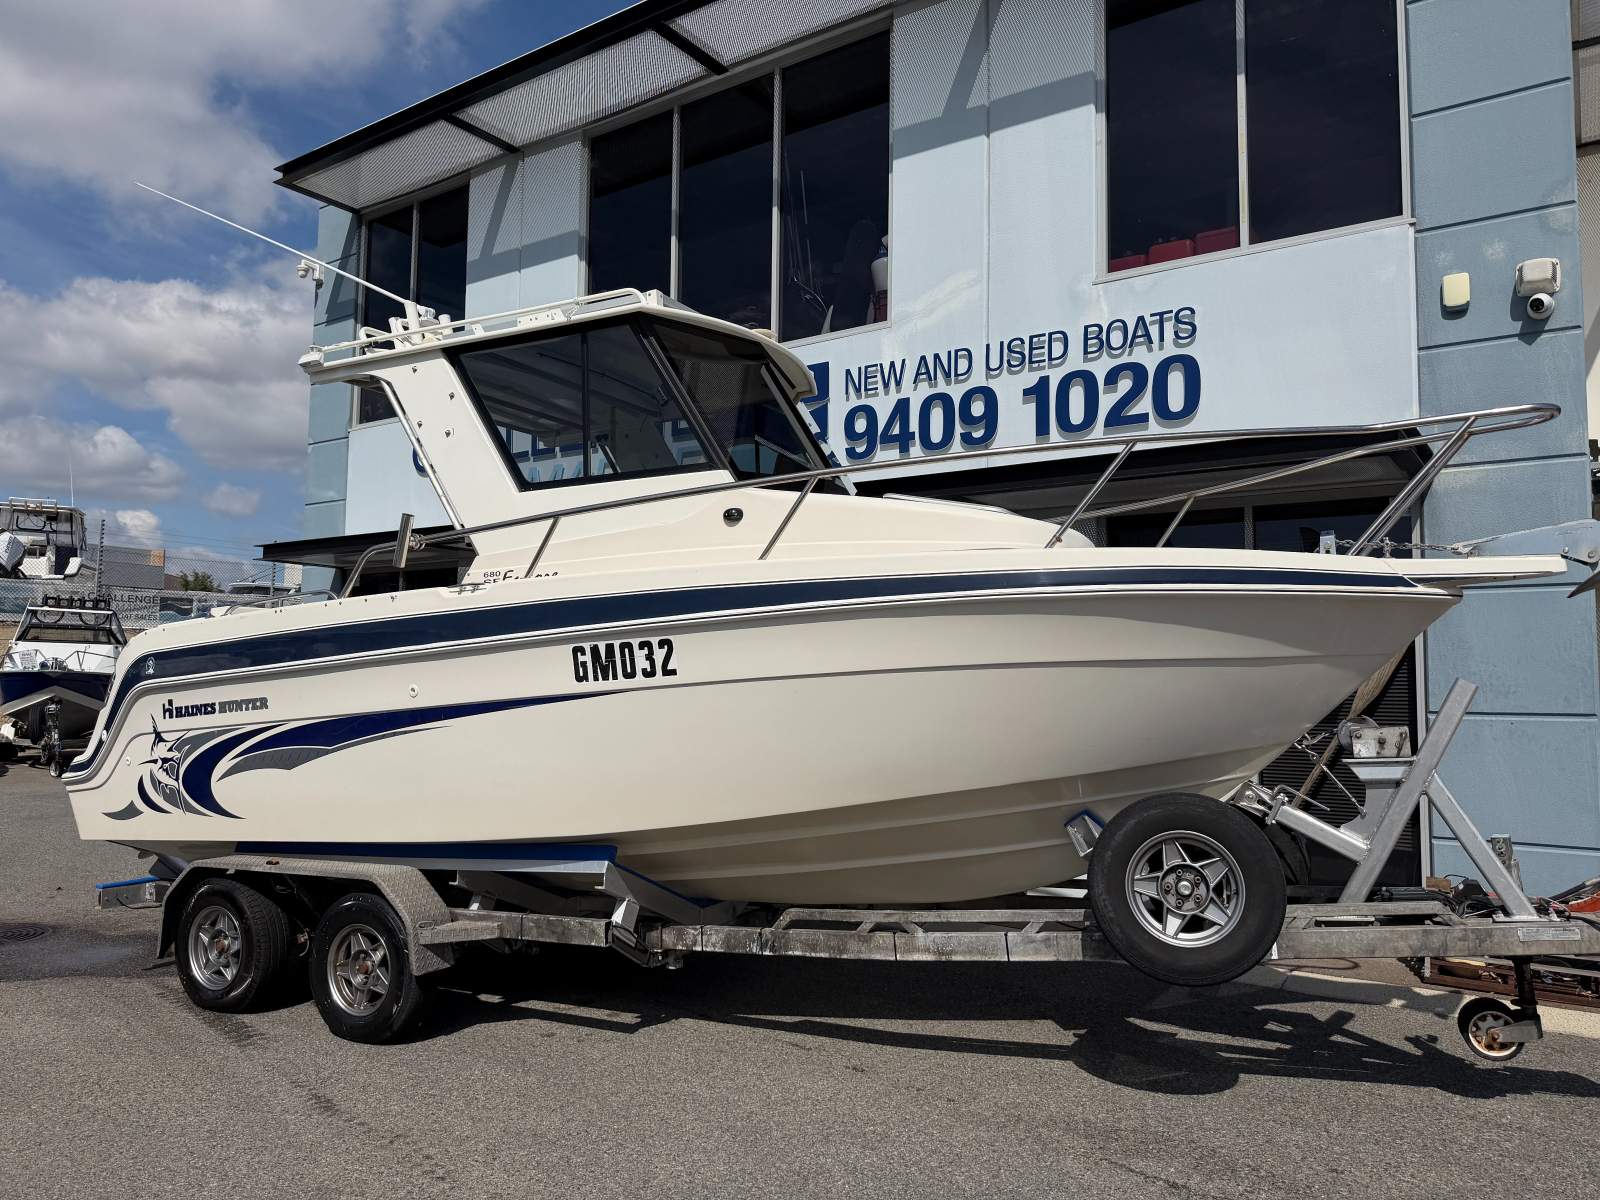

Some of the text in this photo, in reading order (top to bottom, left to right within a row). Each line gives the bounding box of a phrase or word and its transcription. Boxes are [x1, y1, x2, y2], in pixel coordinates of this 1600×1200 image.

[845, 306, 1198, 396] NEW AND USED BOATS
[844, 353, 1201, 461] 9409 1020
[483, 570, 501, 579] 680
[571, 637, 678, 683] GM032
[175, 702, 217, 718] HAINES
[218, 697, 269, 714] HUNTER
